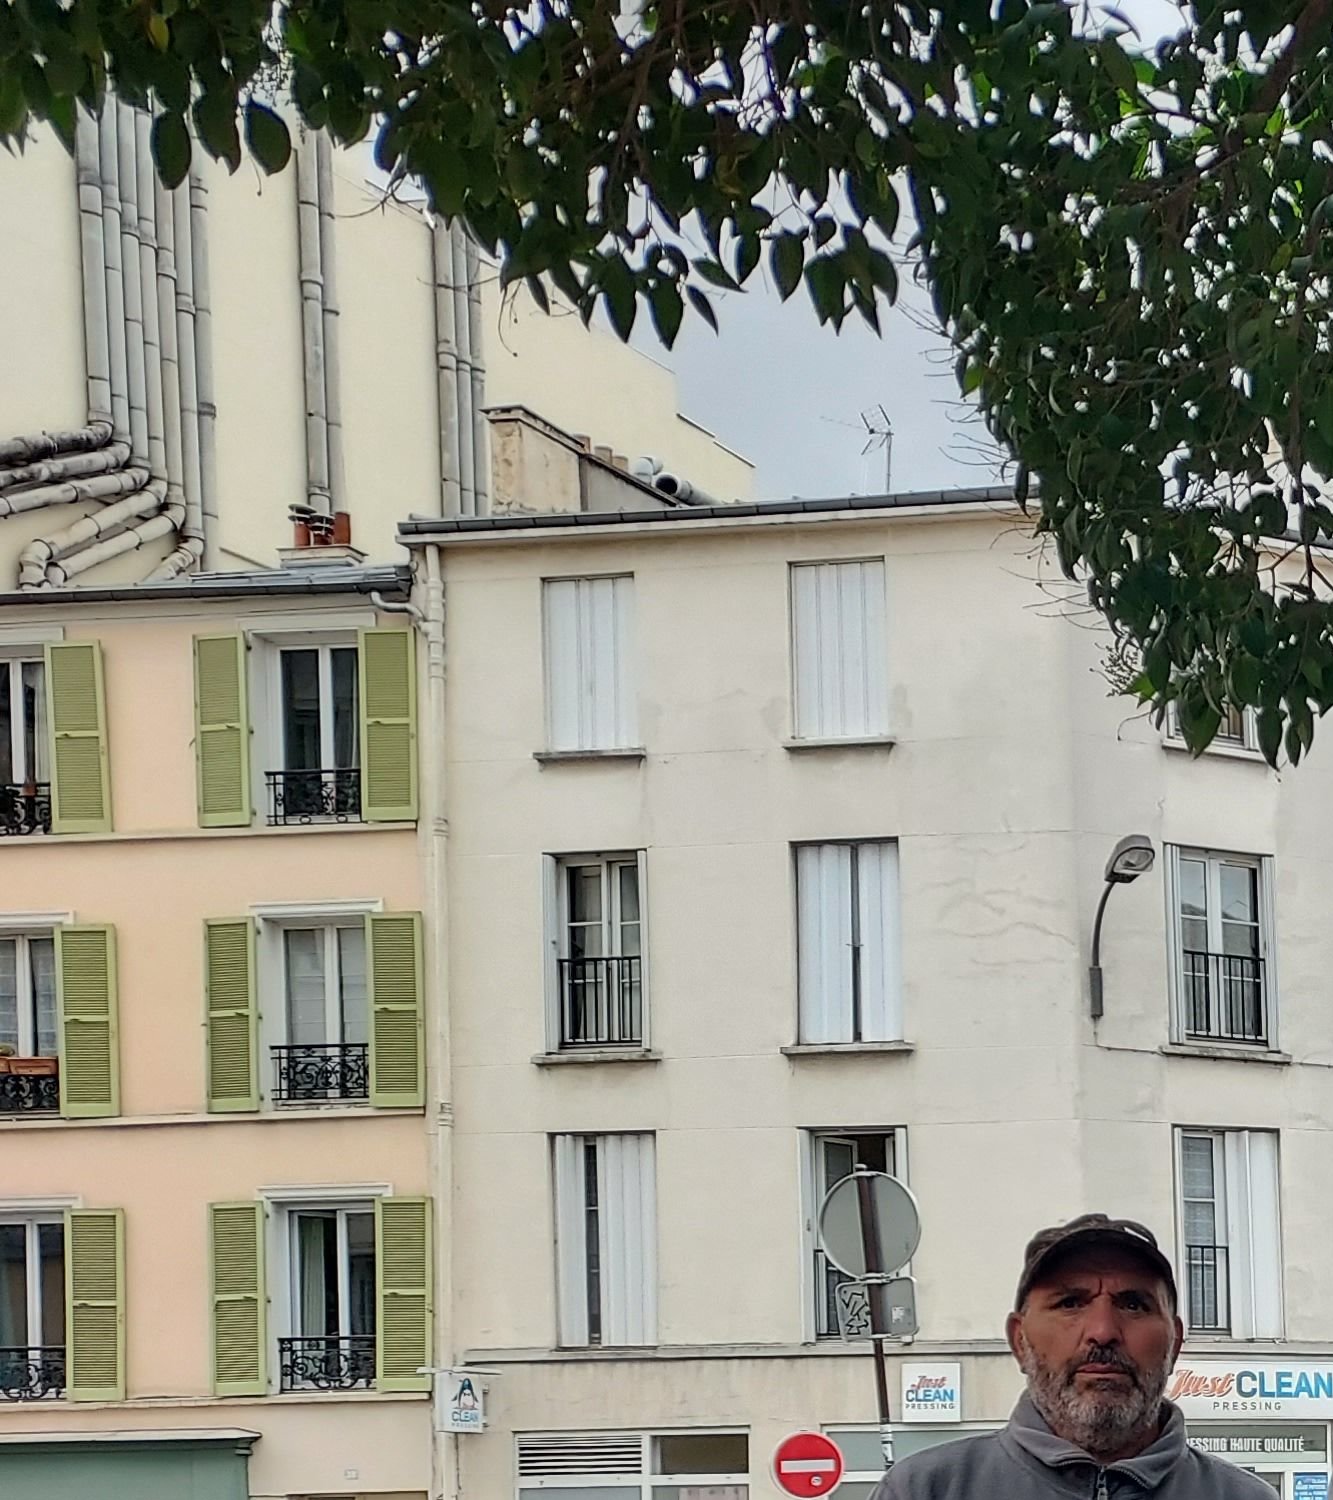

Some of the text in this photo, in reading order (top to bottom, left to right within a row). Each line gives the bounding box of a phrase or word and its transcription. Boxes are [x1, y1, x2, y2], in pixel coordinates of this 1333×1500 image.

[910, 1375, 947, 1391] Just
[1169, 1368, 1333, 1401] Just CLEAN
[905, 1388, 955, 1403] CLEAN
[1213, 1401, 1282, 1411] PRESSING
[1229, 1437, 1263, 1452] HAUTE
[1264, 1434, 1305, 1453] QUALITÉ
